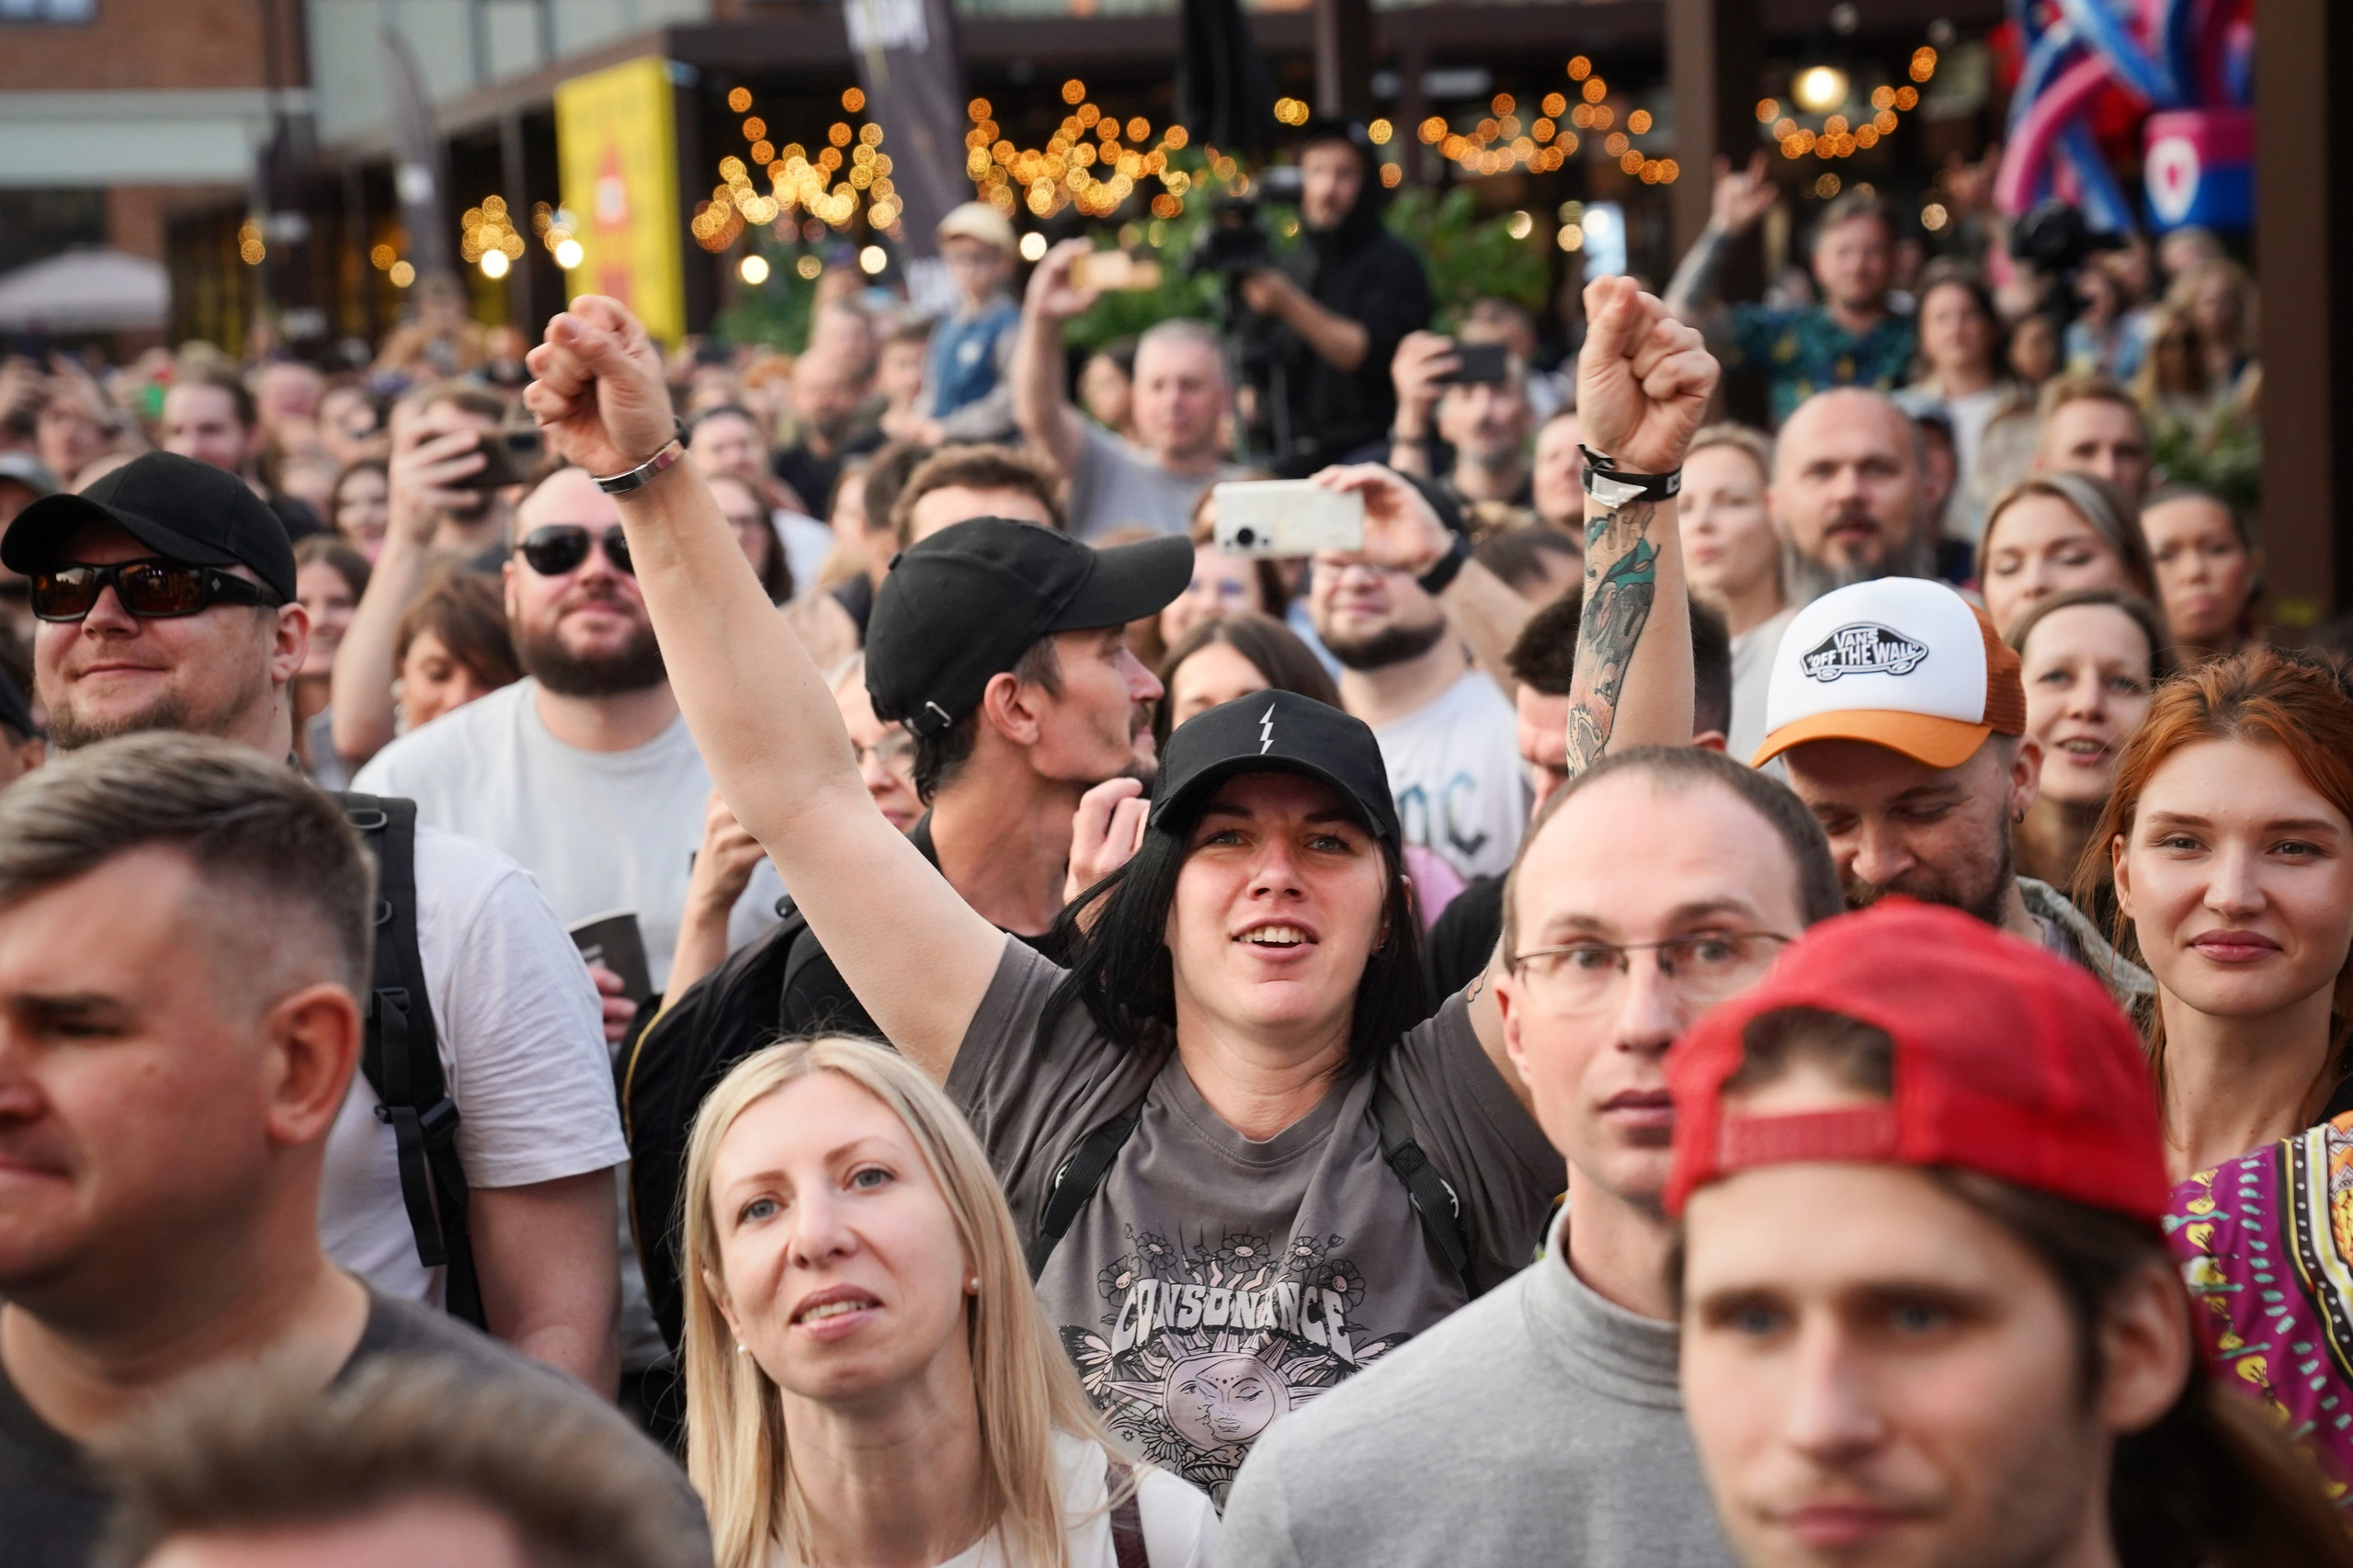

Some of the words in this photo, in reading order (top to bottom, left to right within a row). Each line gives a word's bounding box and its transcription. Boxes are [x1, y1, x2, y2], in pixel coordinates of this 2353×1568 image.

[1834, 627, 1879, 651] VANS
[1841, 644, 1873, 665] THE
[1111, 1278, 1355, 1364] CONSONANCE
